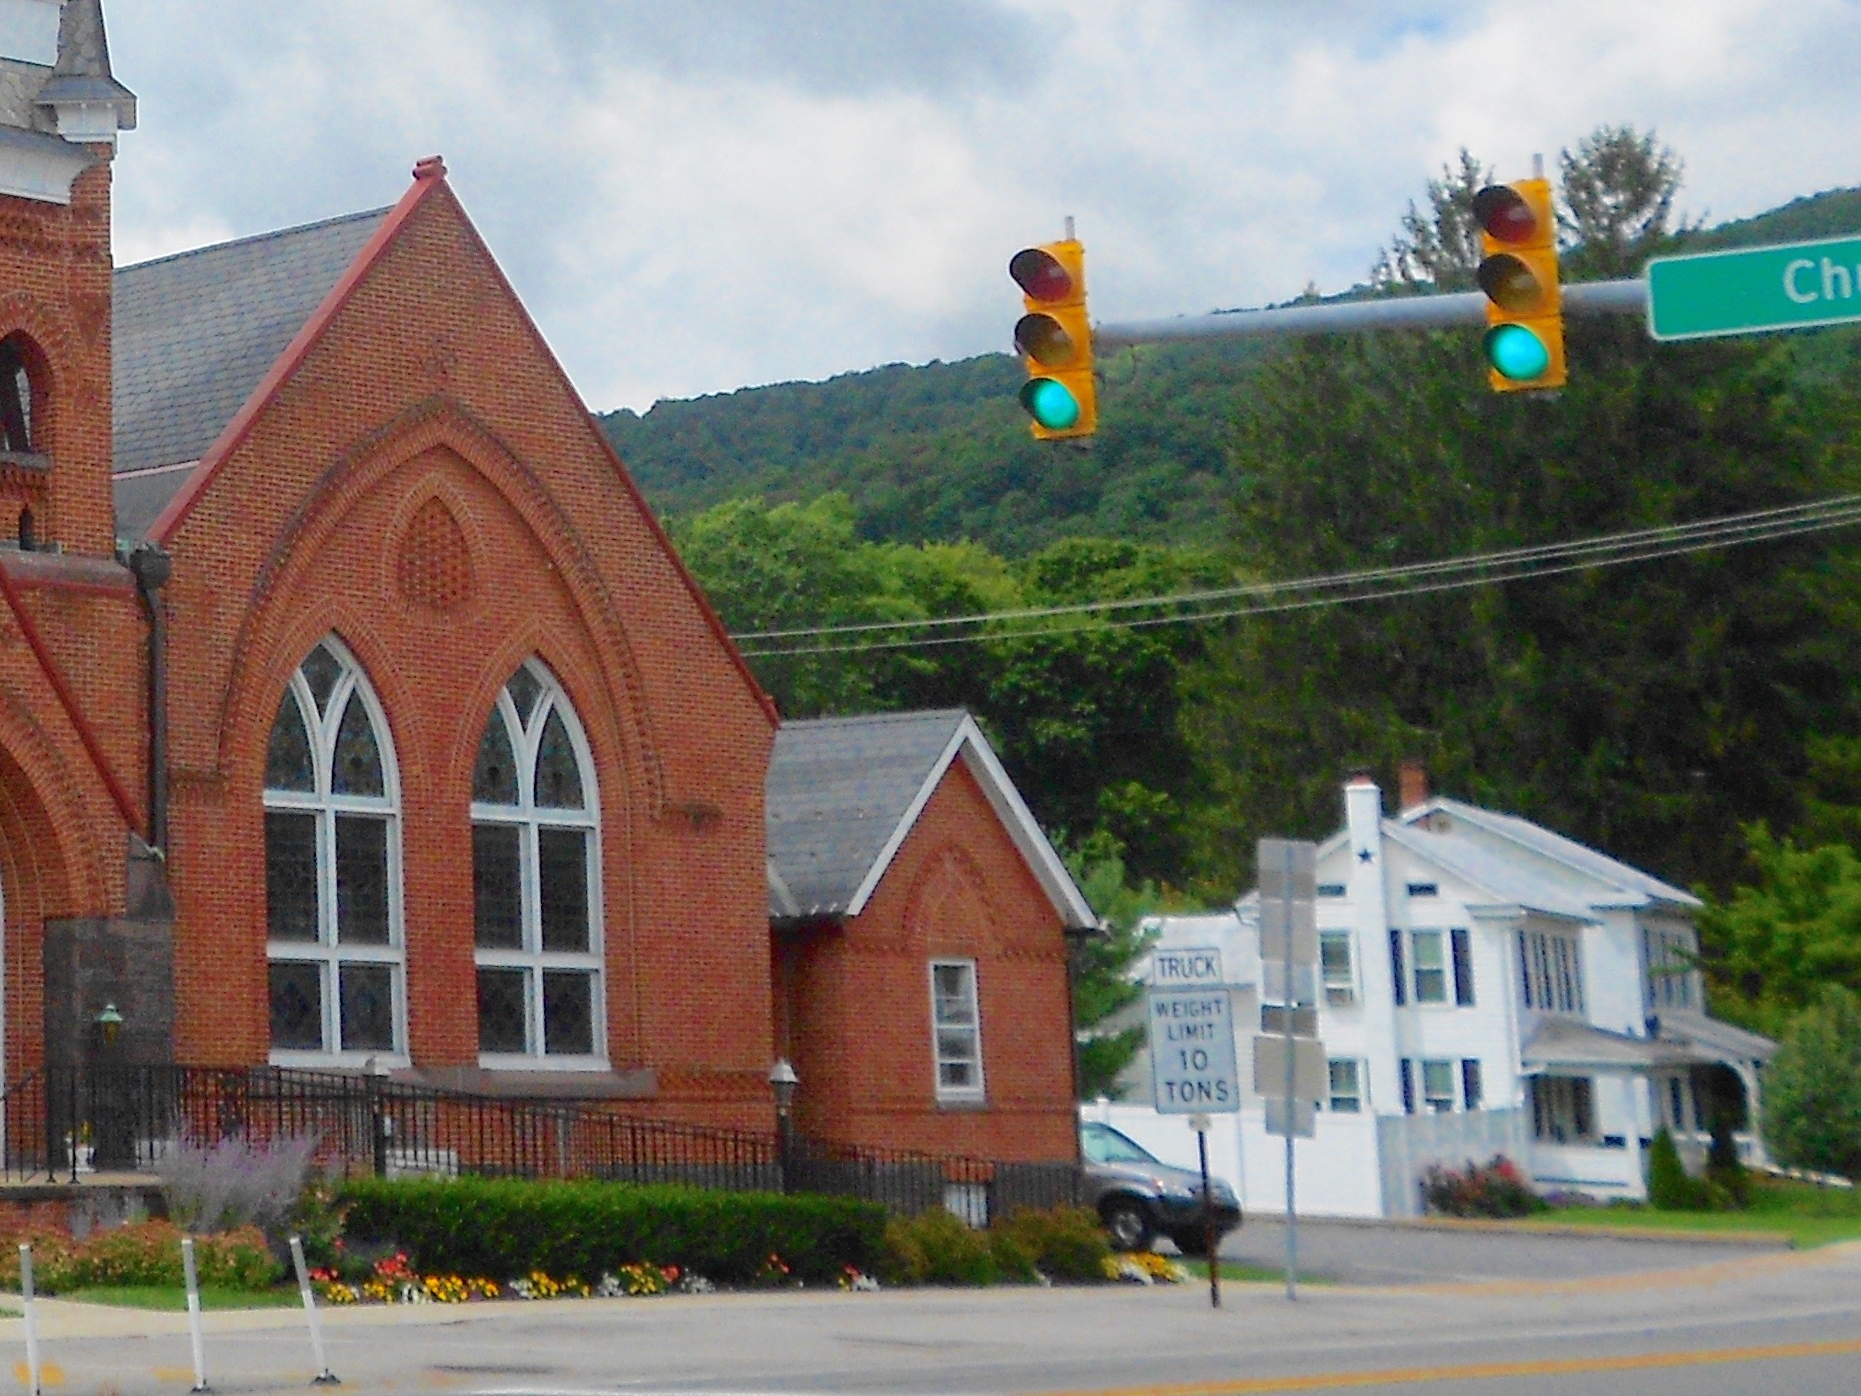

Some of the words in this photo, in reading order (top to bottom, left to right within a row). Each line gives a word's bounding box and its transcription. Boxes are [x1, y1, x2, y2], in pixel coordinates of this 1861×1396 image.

[1783, 257, 1861, 303] Ch
[1158, 956, 1217, 979] TRUCK
[1156, 999, 1223, 1018] WEIGHT
[1168, 1024, 1214, 1041] LIMIT
[1180, 1050, 1208, 1071] 10
[1165, 1080, 1228, 1102] TONS
